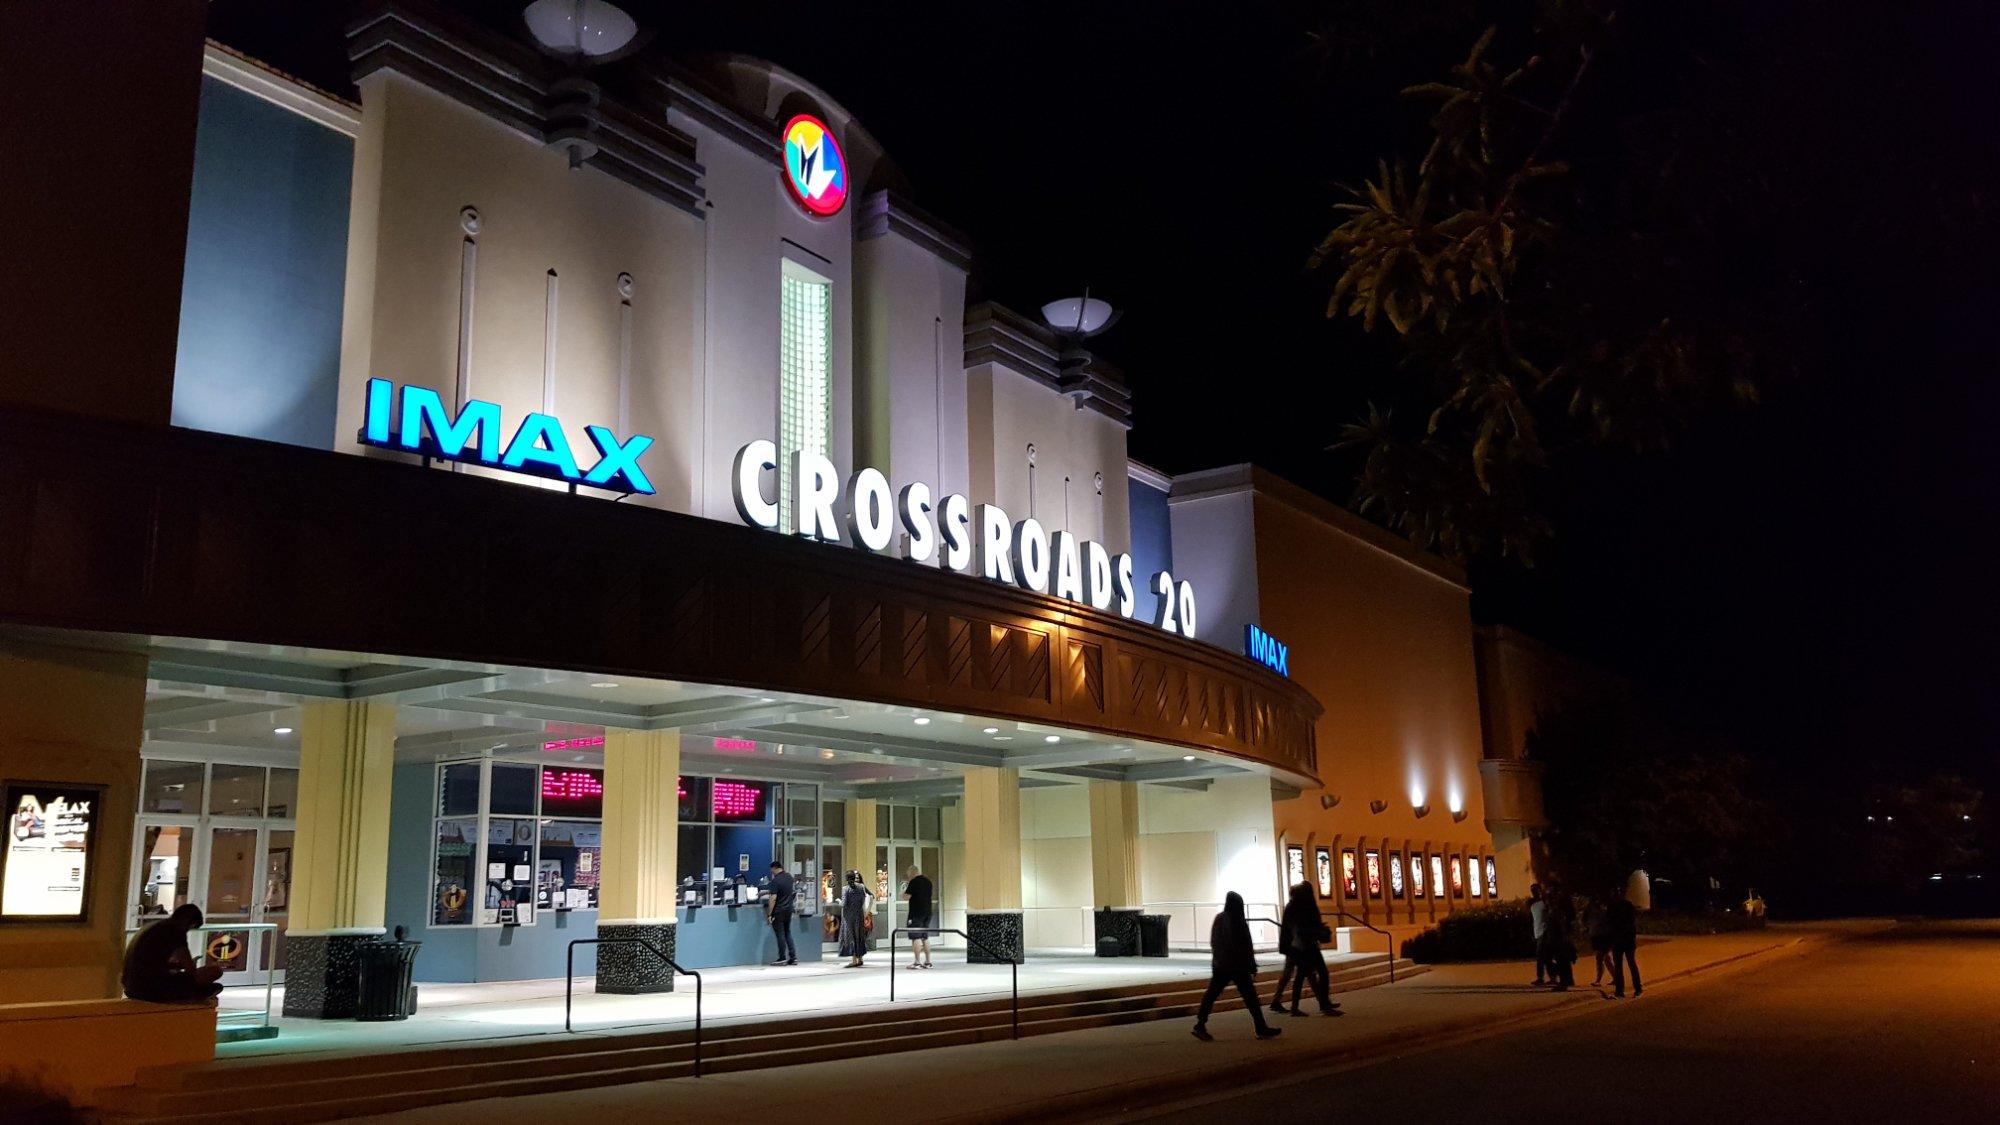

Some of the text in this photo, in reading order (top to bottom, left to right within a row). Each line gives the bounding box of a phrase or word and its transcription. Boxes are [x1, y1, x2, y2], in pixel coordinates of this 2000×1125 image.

[365, 378, 656, 495] IMAX
[732, 440, 1197, 638] CROSSROADS 20
[1250, 624, 1288, 677] IMAX
